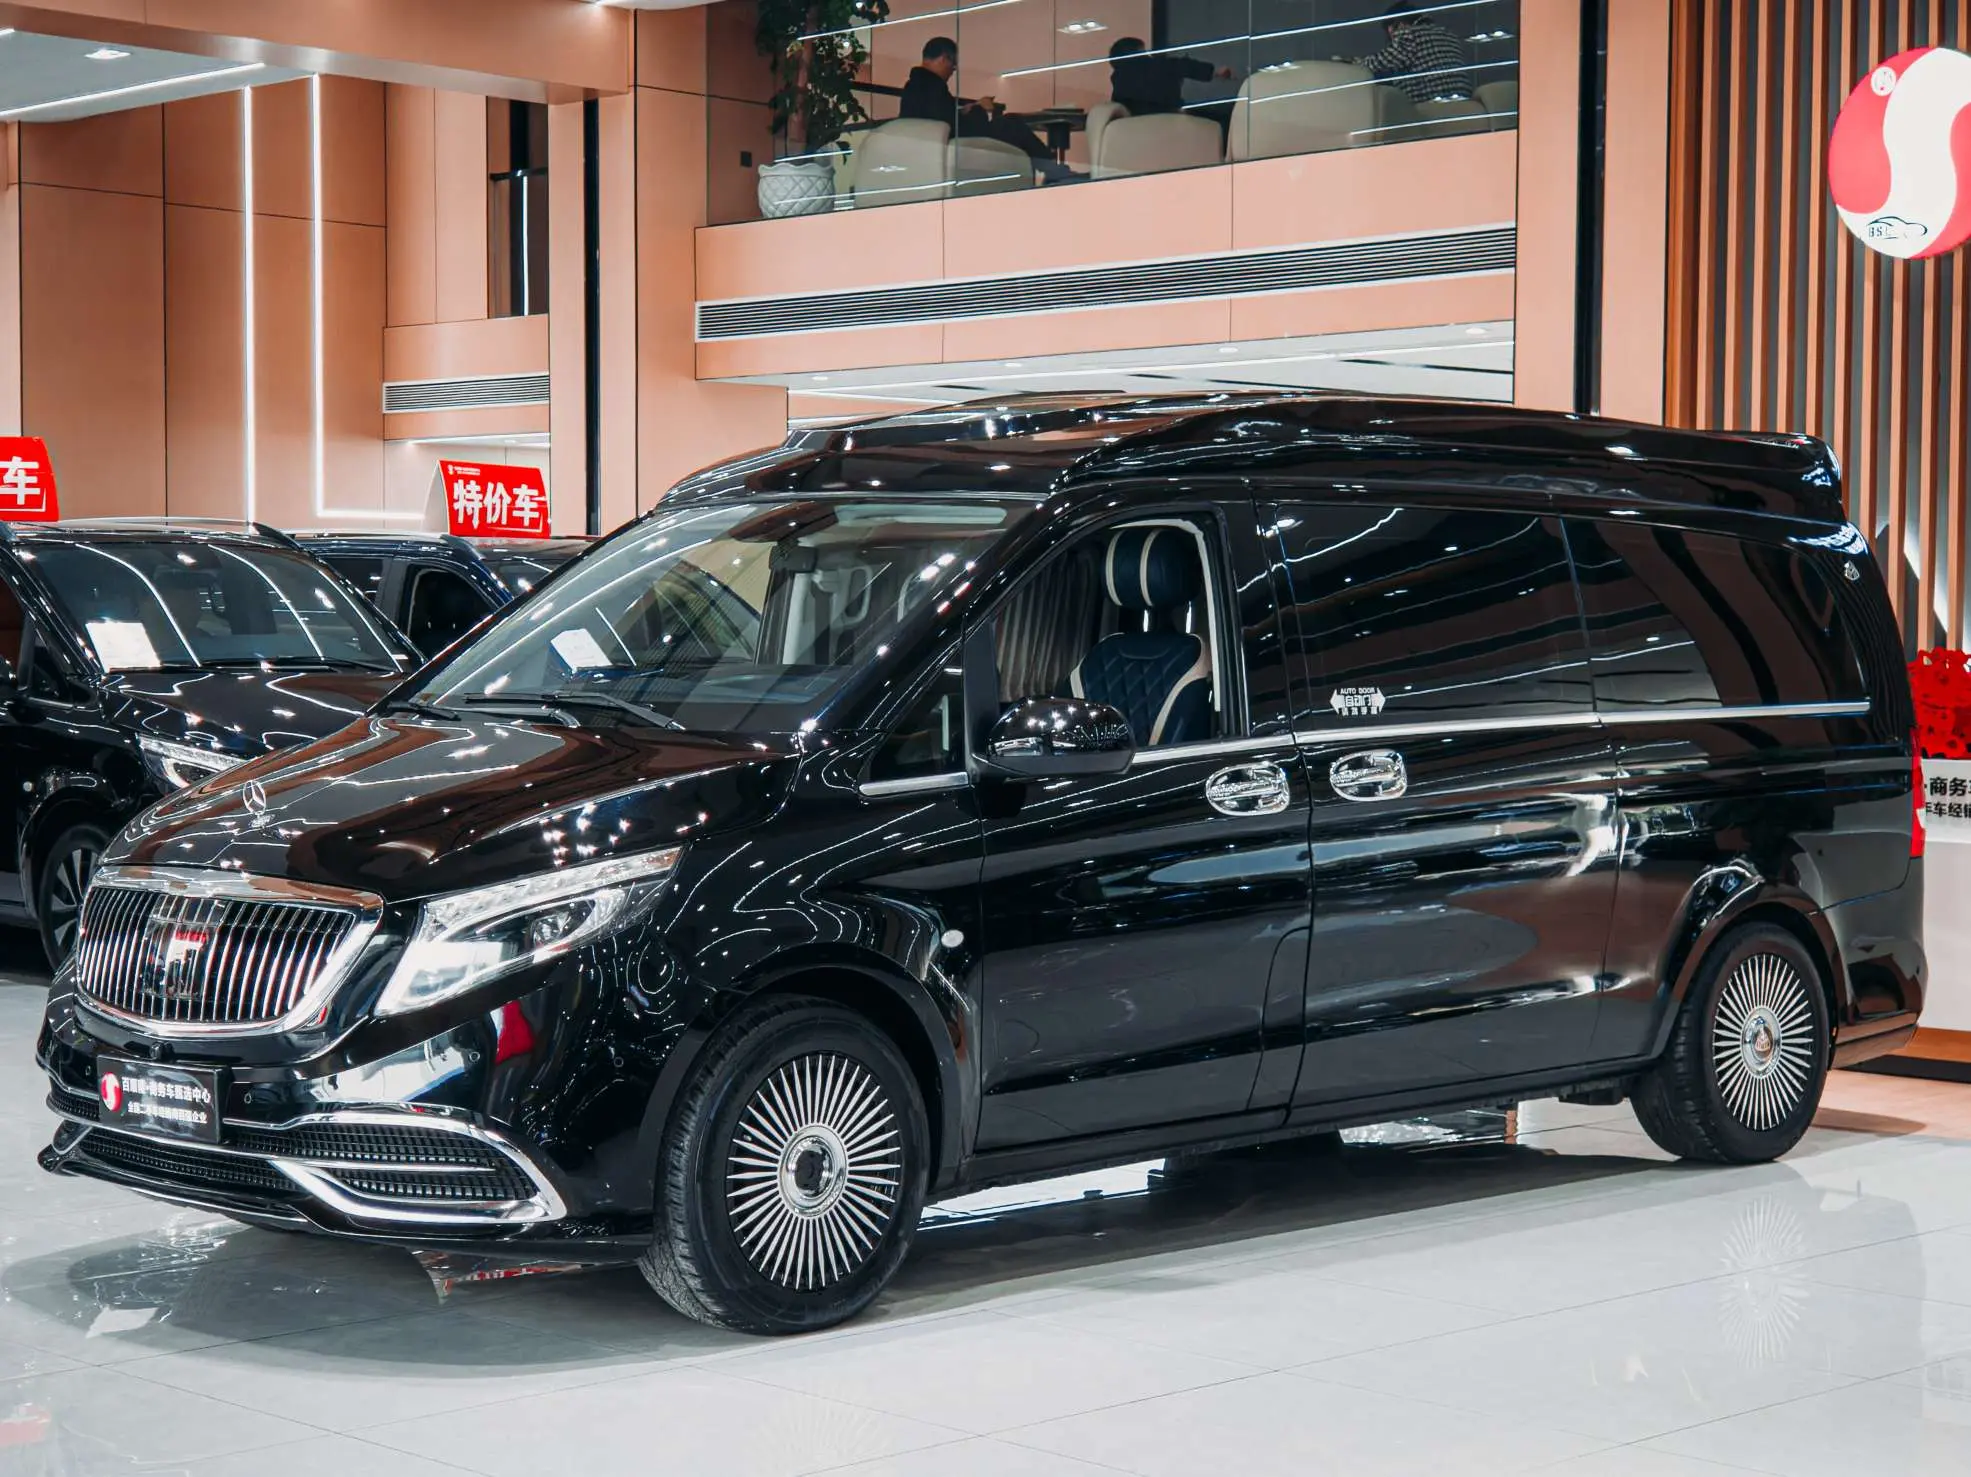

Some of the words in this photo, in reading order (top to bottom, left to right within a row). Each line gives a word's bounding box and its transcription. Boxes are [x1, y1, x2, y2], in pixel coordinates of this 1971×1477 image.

[0, 456, 40, 505] 车
[453, 479, 540, 529] 特价车
[1340, 687, 1357, 695] AUTO
[1924, 776, 1971, 796] ·商务
